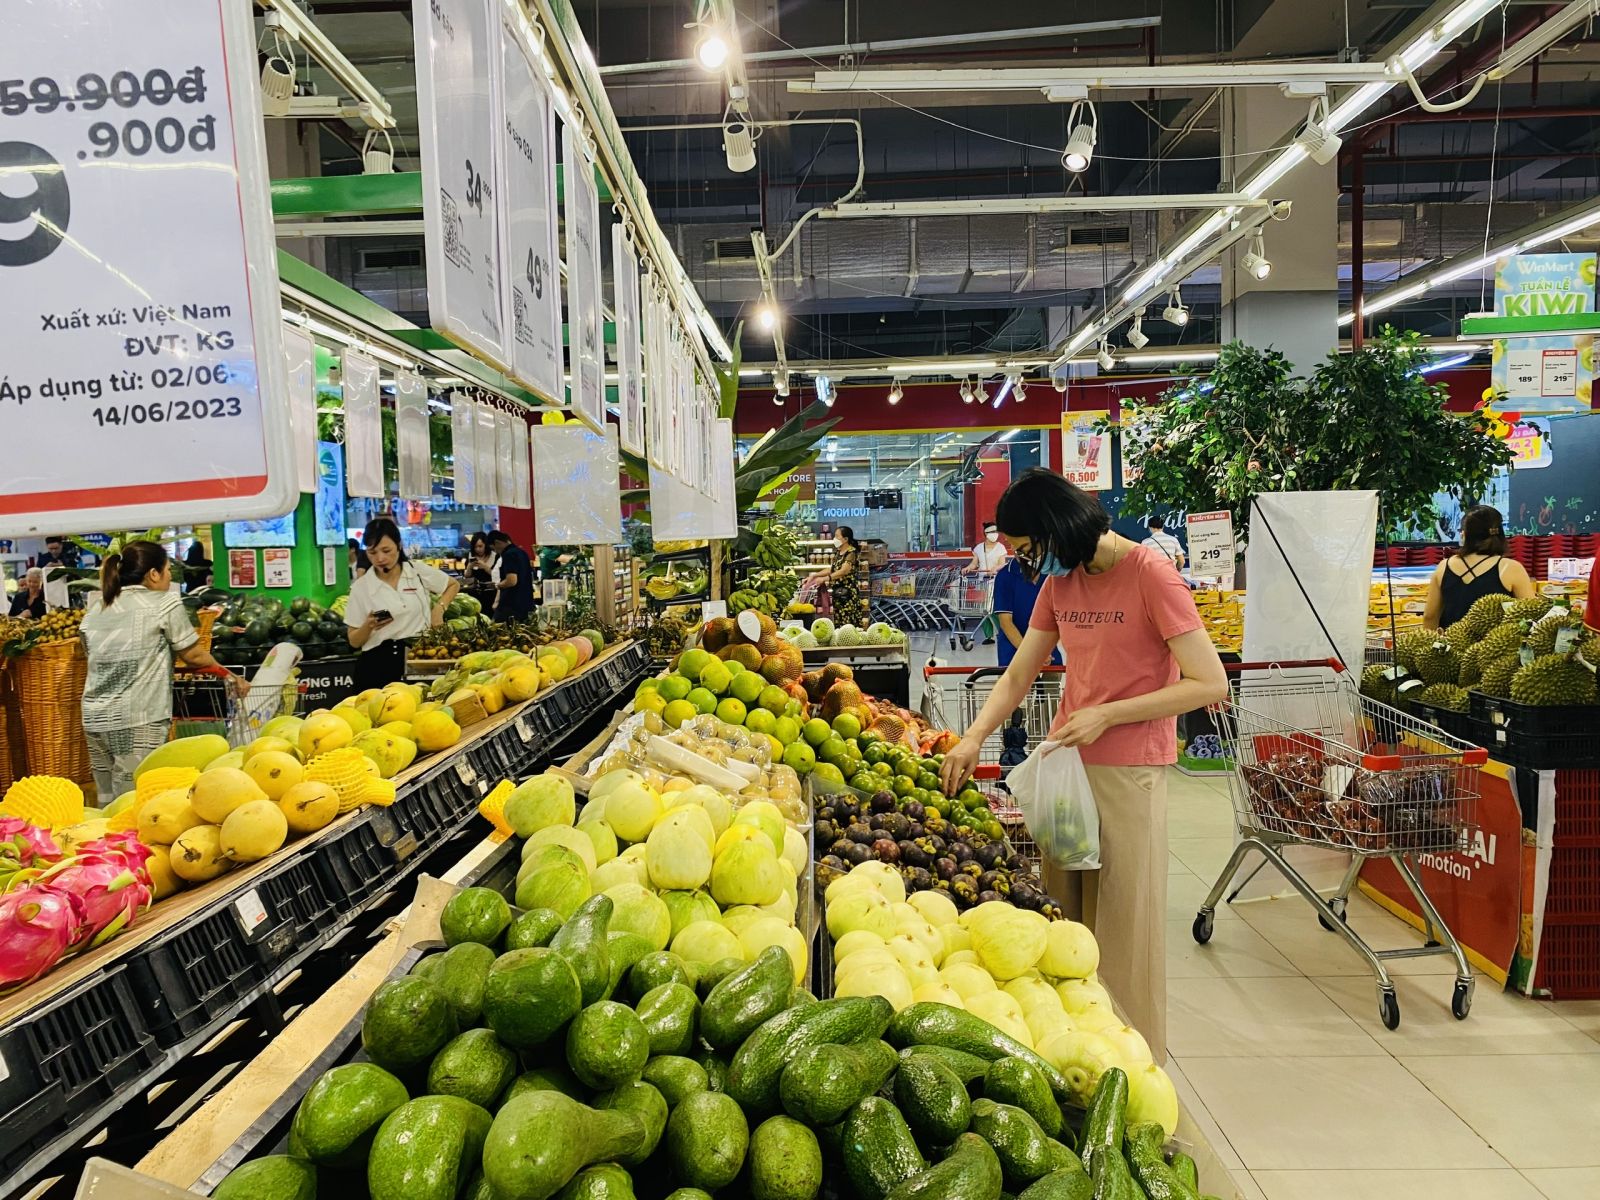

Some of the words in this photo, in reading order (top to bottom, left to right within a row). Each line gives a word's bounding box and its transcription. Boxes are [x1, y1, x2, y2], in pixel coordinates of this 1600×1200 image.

[466, 159, 483, 219] 34
[526, 247, 543, 301] 49
[1516, 260, 1575, 275] WinMart
[41, 307, 90, 331] Xuất
[96, 308, 127, 328] xứ:
[132, 304, 175, 326] Việt
[182, 303, 231, 320] Nam
[1503, 292, 1587, 317] KIWI
[124, 334, 188, 357] ĐVT:
[197, 330, 234, 351] KG
[0, 375, 32, 405] Áp
[39, 377, 102, 401] dụng
[109, 369, 144, 392] từ:
[92, 396, 242, 427] 14/06/2023
[1200, 549, 1220, 560] 219
[1054, 609, 1125, 624] SABOTEUR
